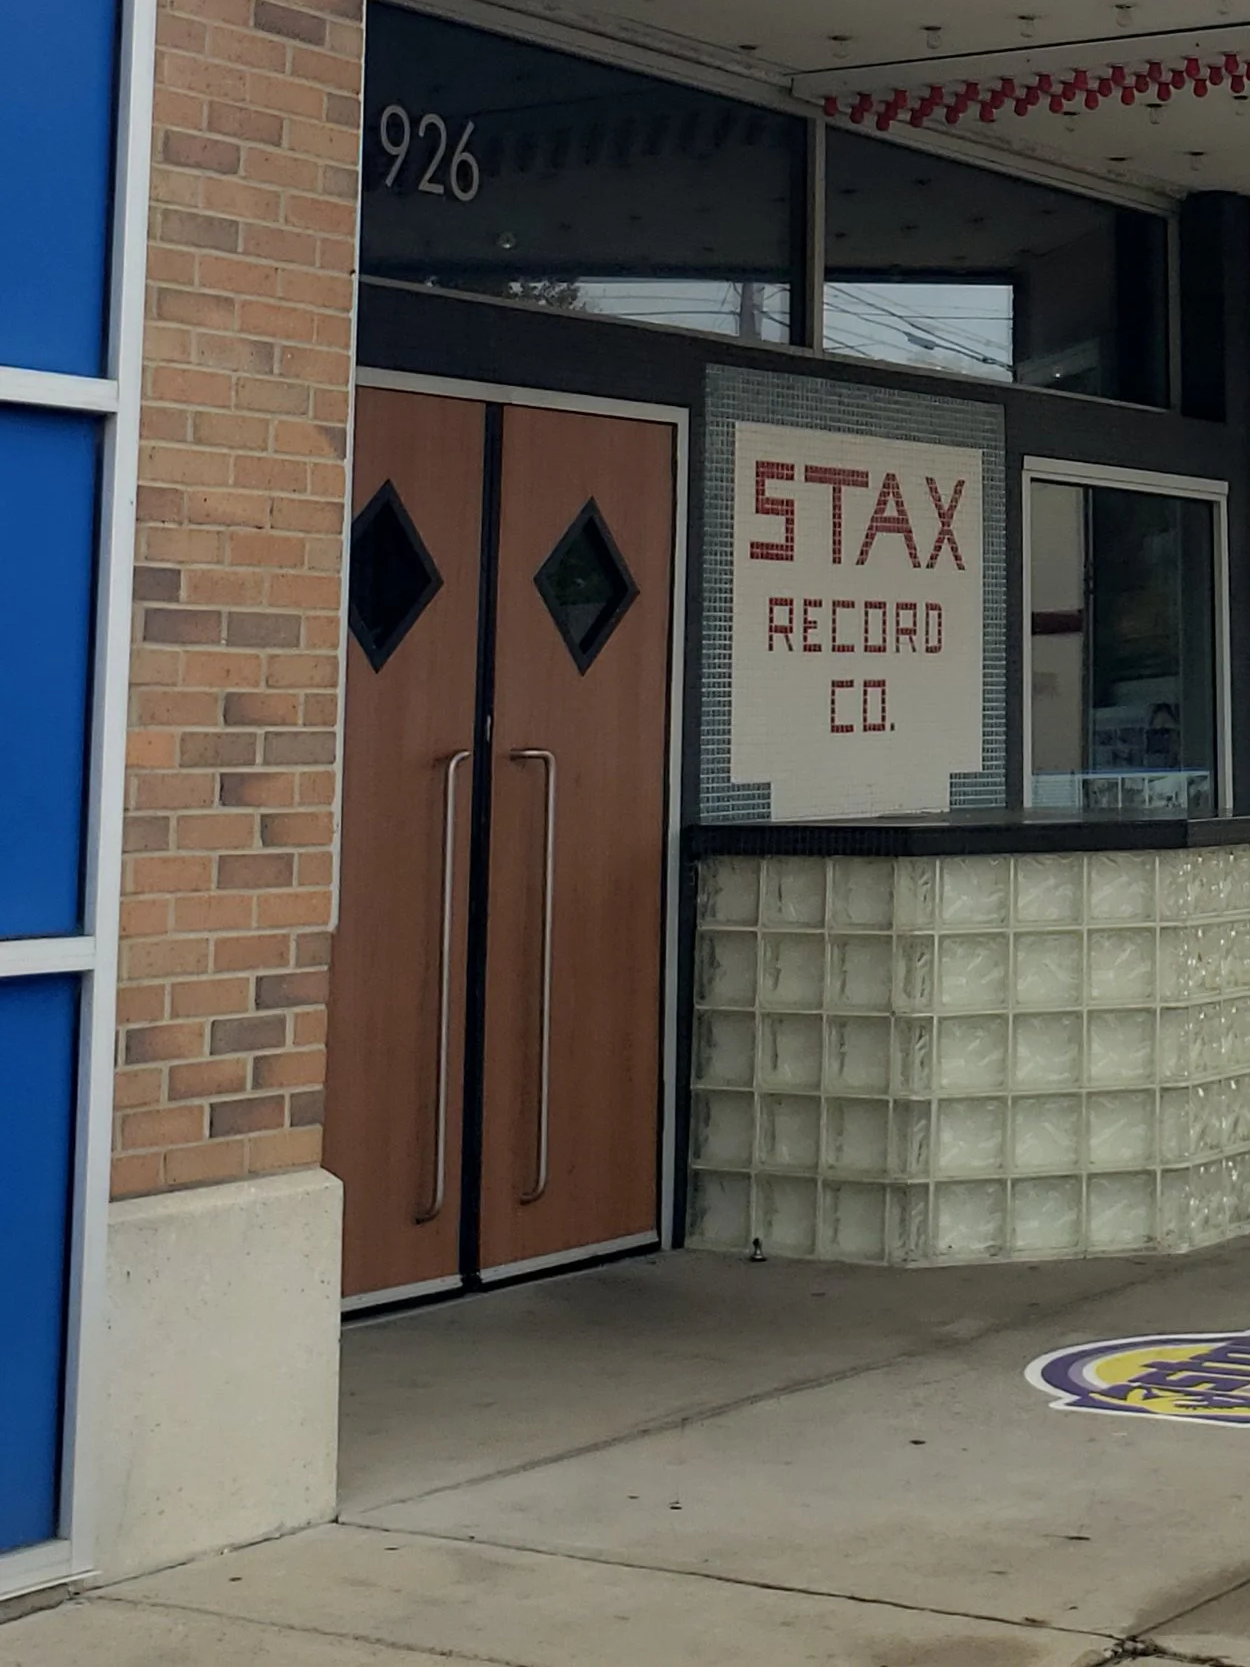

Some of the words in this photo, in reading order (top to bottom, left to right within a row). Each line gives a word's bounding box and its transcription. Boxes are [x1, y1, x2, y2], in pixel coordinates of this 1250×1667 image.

[380, 104, 481, 202] 926
[749, 460, 966, 571] STAX
[768, 597, 944, 654] RECORD
[830, 679, 896, 734] CO.
